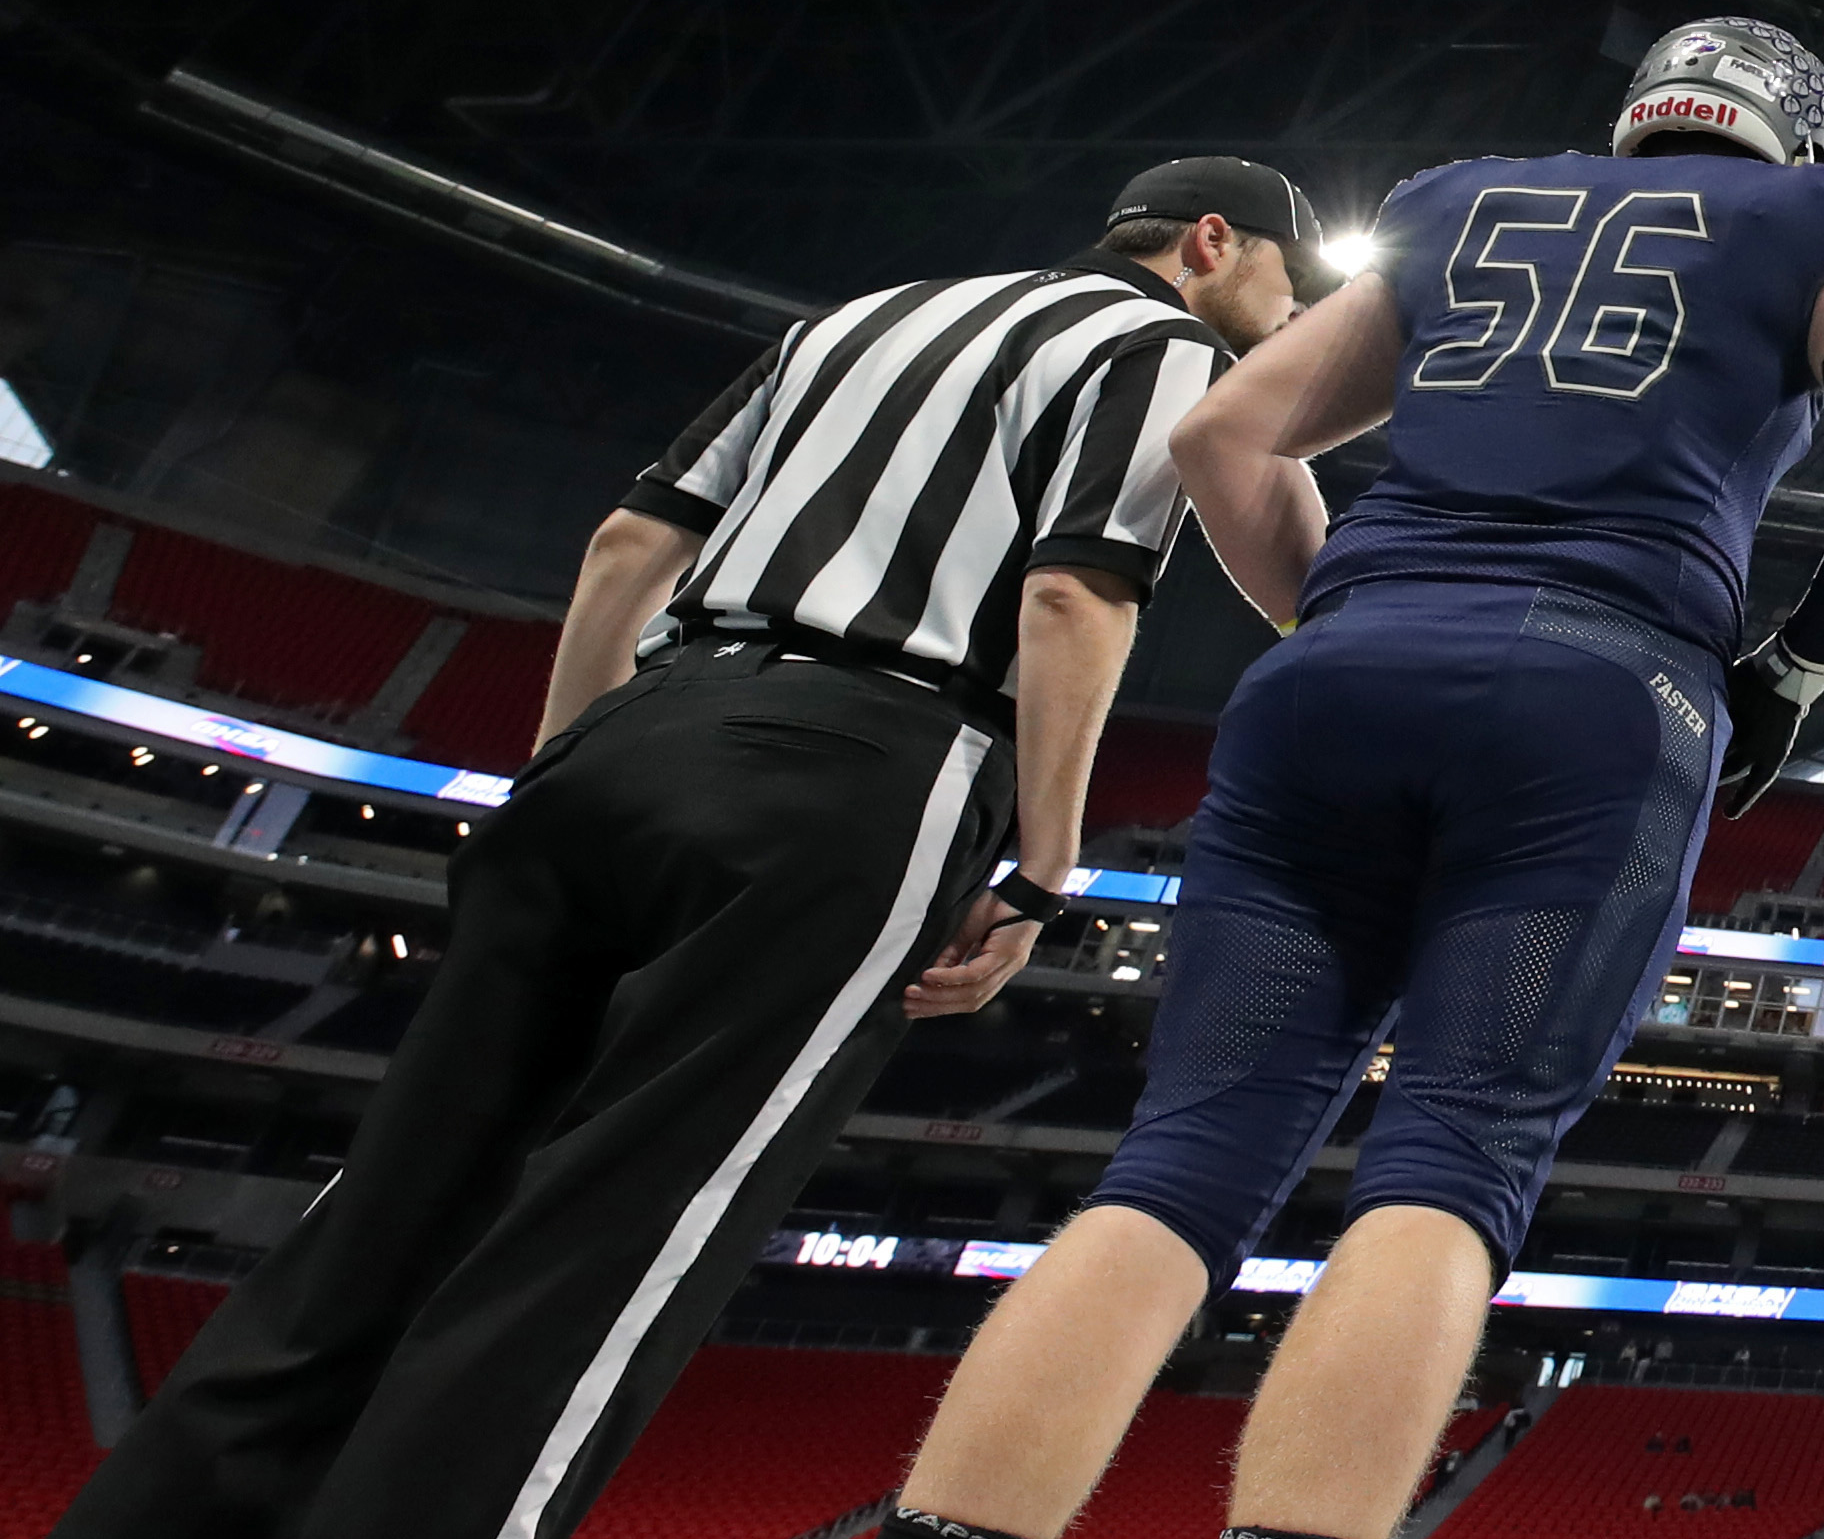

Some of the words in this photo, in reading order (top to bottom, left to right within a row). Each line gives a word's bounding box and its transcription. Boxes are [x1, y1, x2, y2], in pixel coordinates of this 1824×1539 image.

[1628, 96, 1739, 128] Riddell
[1410, 186, 1714, 401] 56
[1648, 671, 1708, 739] FASTER
[796, 1231, 899, 1269] 10:04
[897, 1506, 985, 1539] VAP
